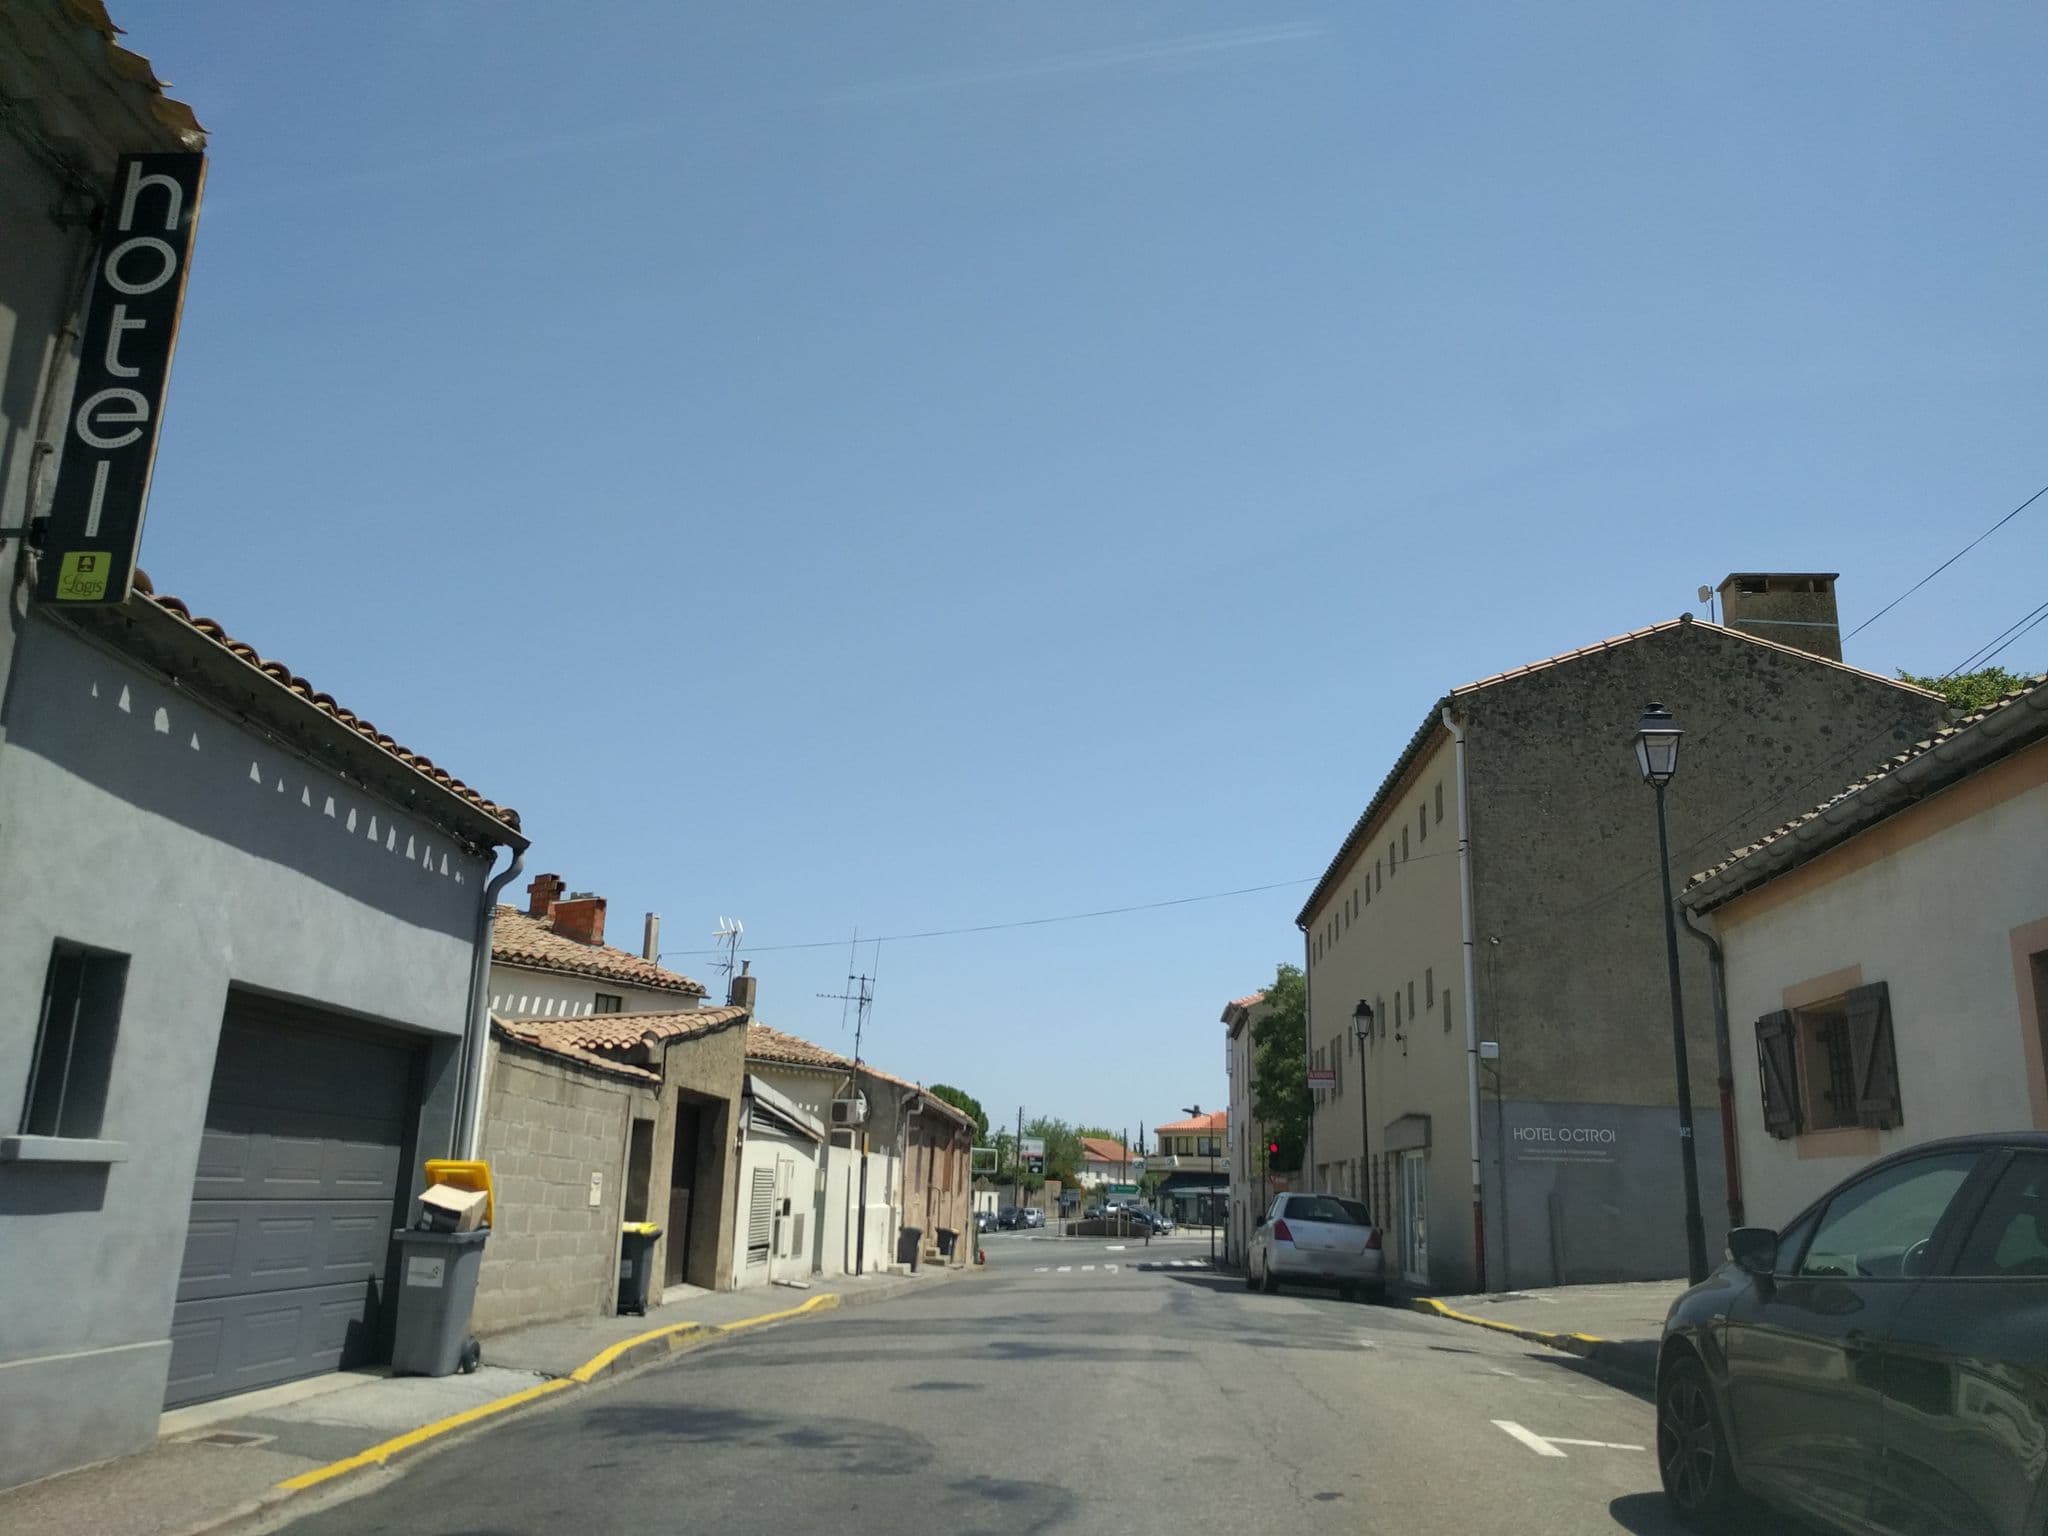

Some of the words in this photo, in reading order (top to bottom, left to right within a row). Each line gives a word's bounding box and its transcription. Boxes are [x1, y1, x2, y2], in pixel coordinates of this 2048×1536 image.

[76, 160, 184, 537] hotel
[63, 575, 103, 596] Logis
[1514, 1127, 1556, 1142] HOTEL
[1558, 1128, 1616, 1142] OCTROI
